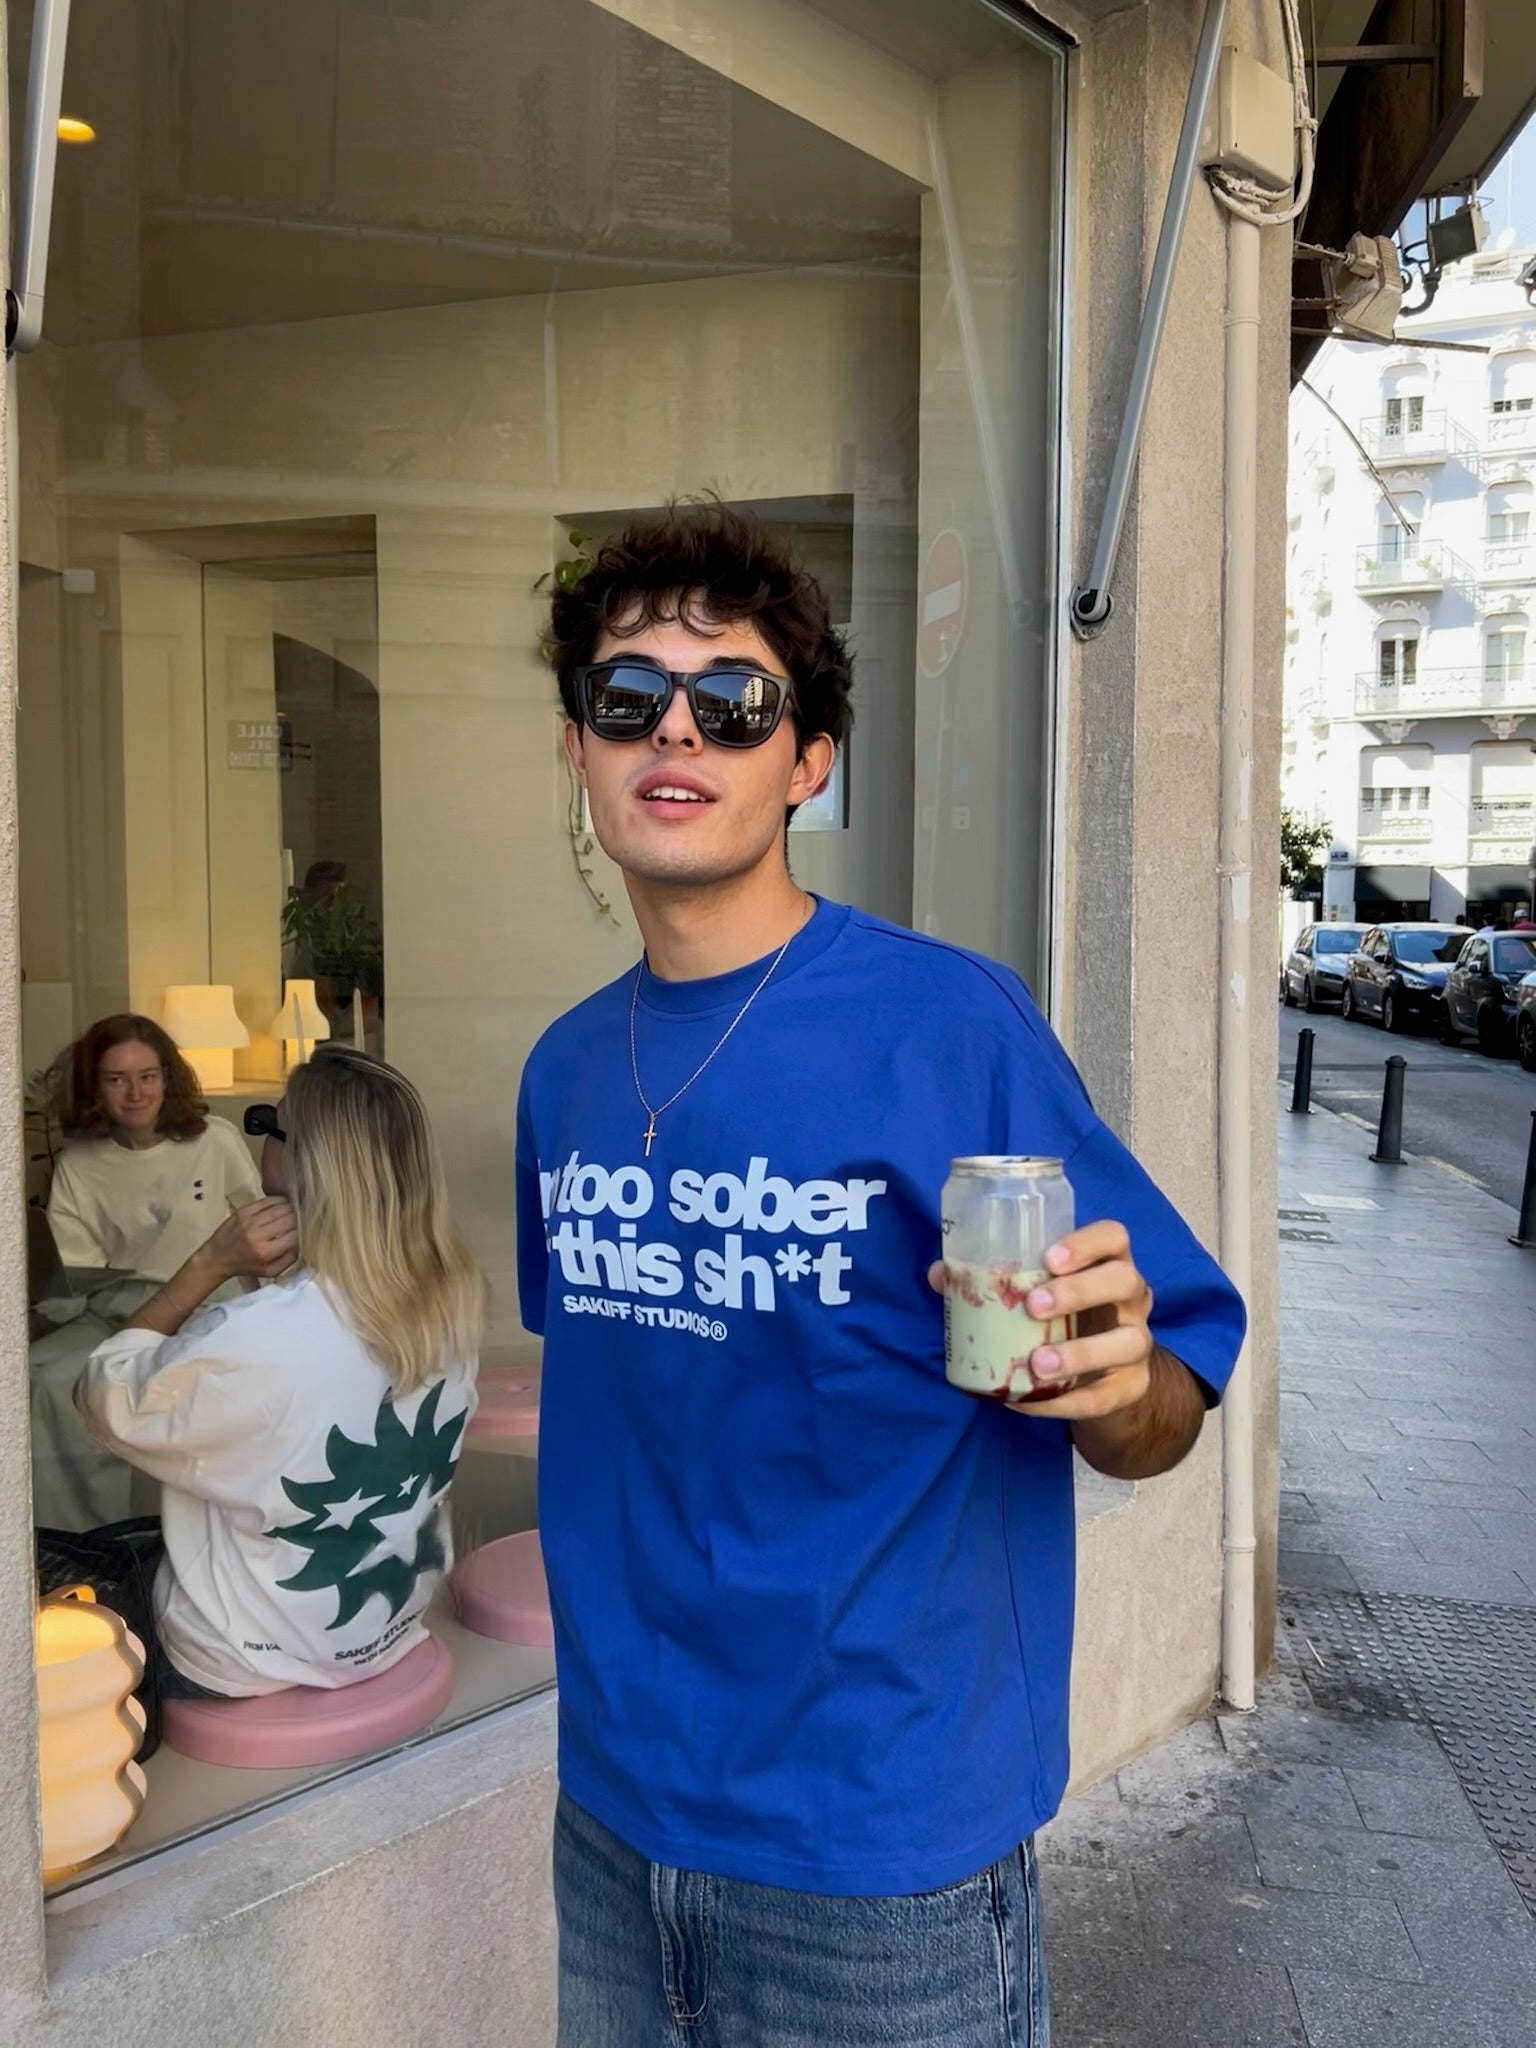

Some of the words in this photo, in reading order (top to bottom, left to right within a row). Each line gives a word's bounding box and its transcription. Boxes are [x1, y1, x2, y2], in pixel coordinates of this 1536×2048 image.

[556, 1150, 654, 1219] too
[668, 1156, 888, 1236] sober
[552, 1219, 684, 1297] this
[562, 1294, 632, 1321] SAKIFF
